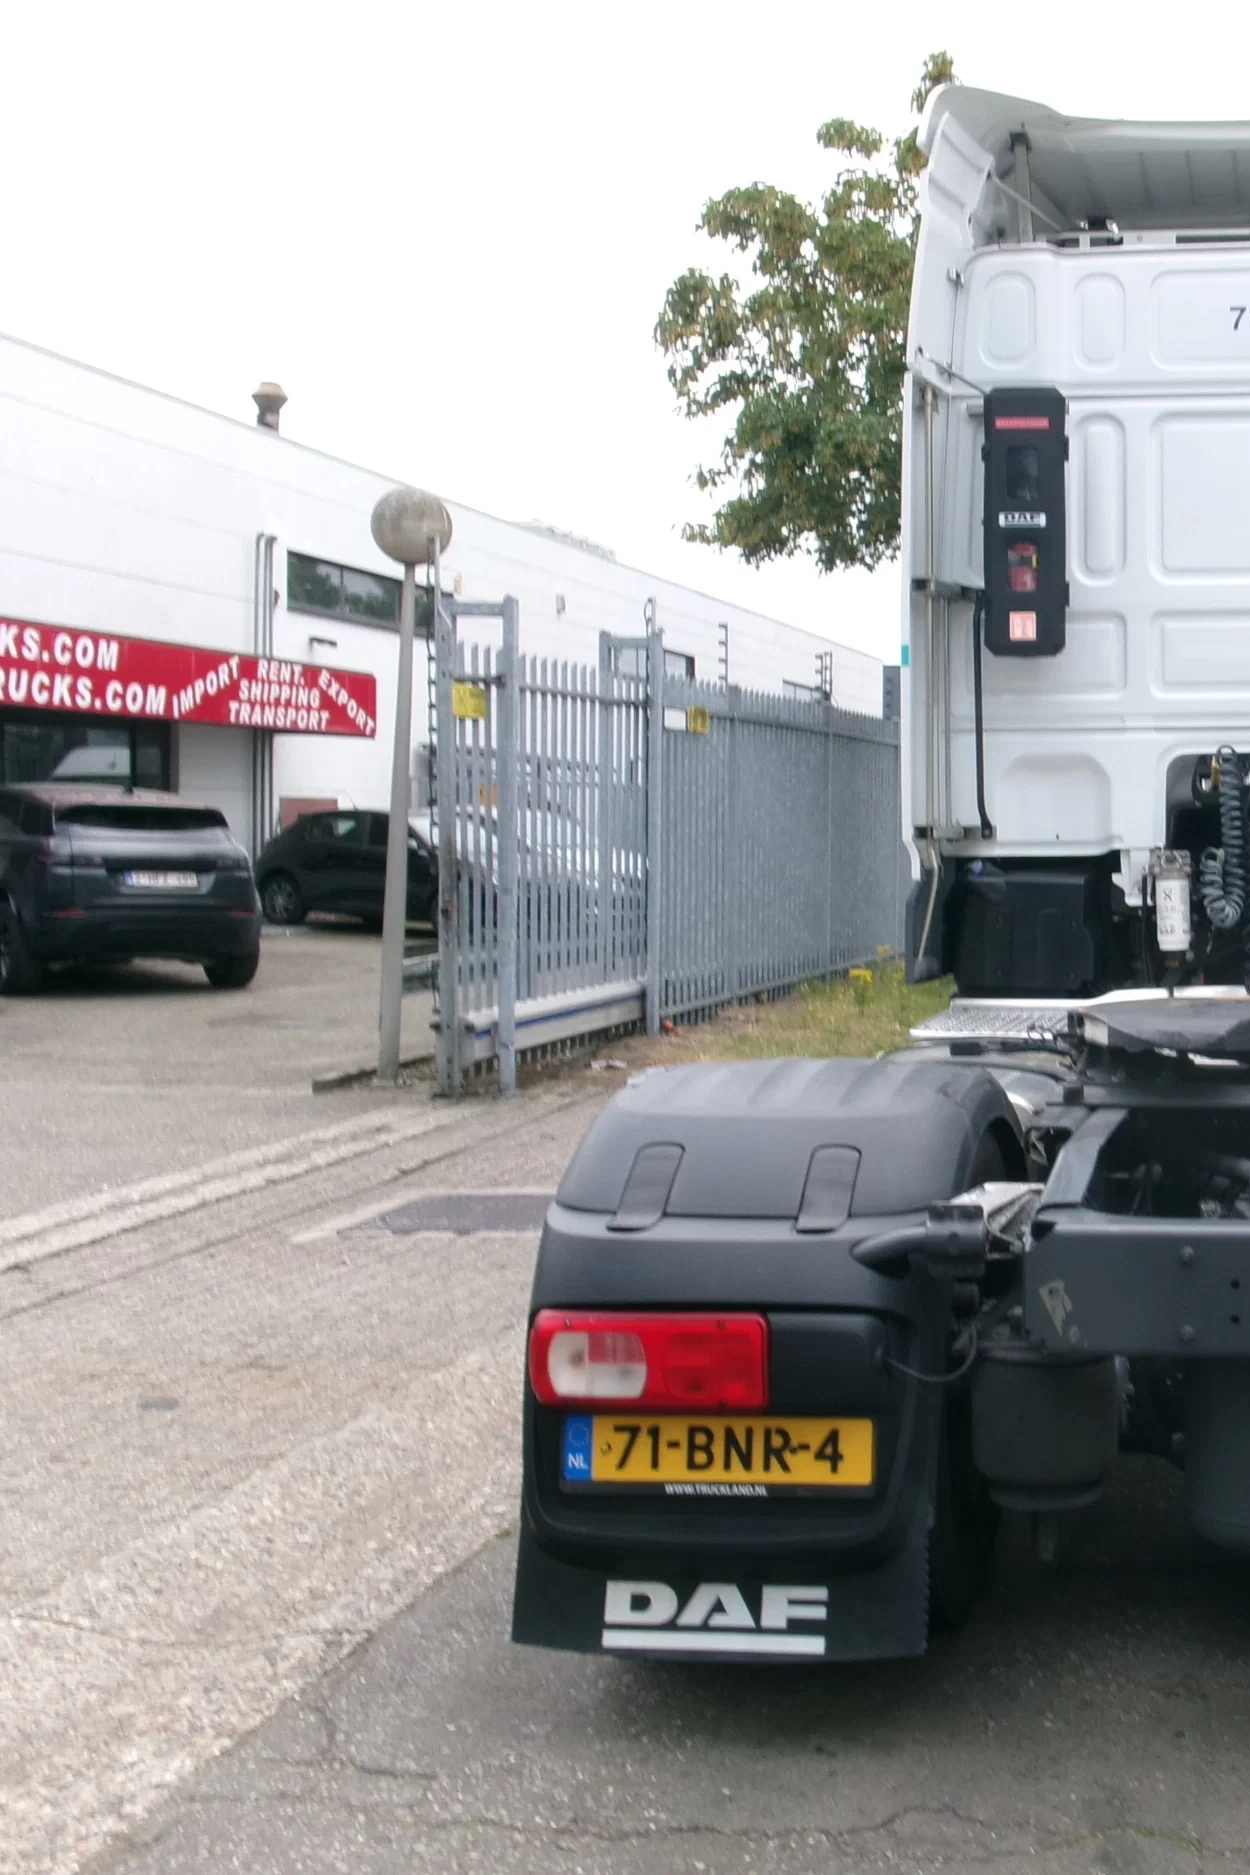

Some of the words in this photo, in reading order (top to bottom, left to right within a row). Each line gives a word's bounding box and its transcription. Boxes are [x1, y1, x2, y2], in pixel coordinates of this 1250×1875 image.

[172, 655, 239, 719] IMPORT
[238, 679, 320, 709] SHIPPING
[318, 668, 375, 736] EXPORT
[229, 700, 329, 731] TRANSPORT
[568, 1452, 589, 1470] NL
[613, 1424, 843, 1474] 71-BNR-4
[604, 1580, 828, 1630] DAF
